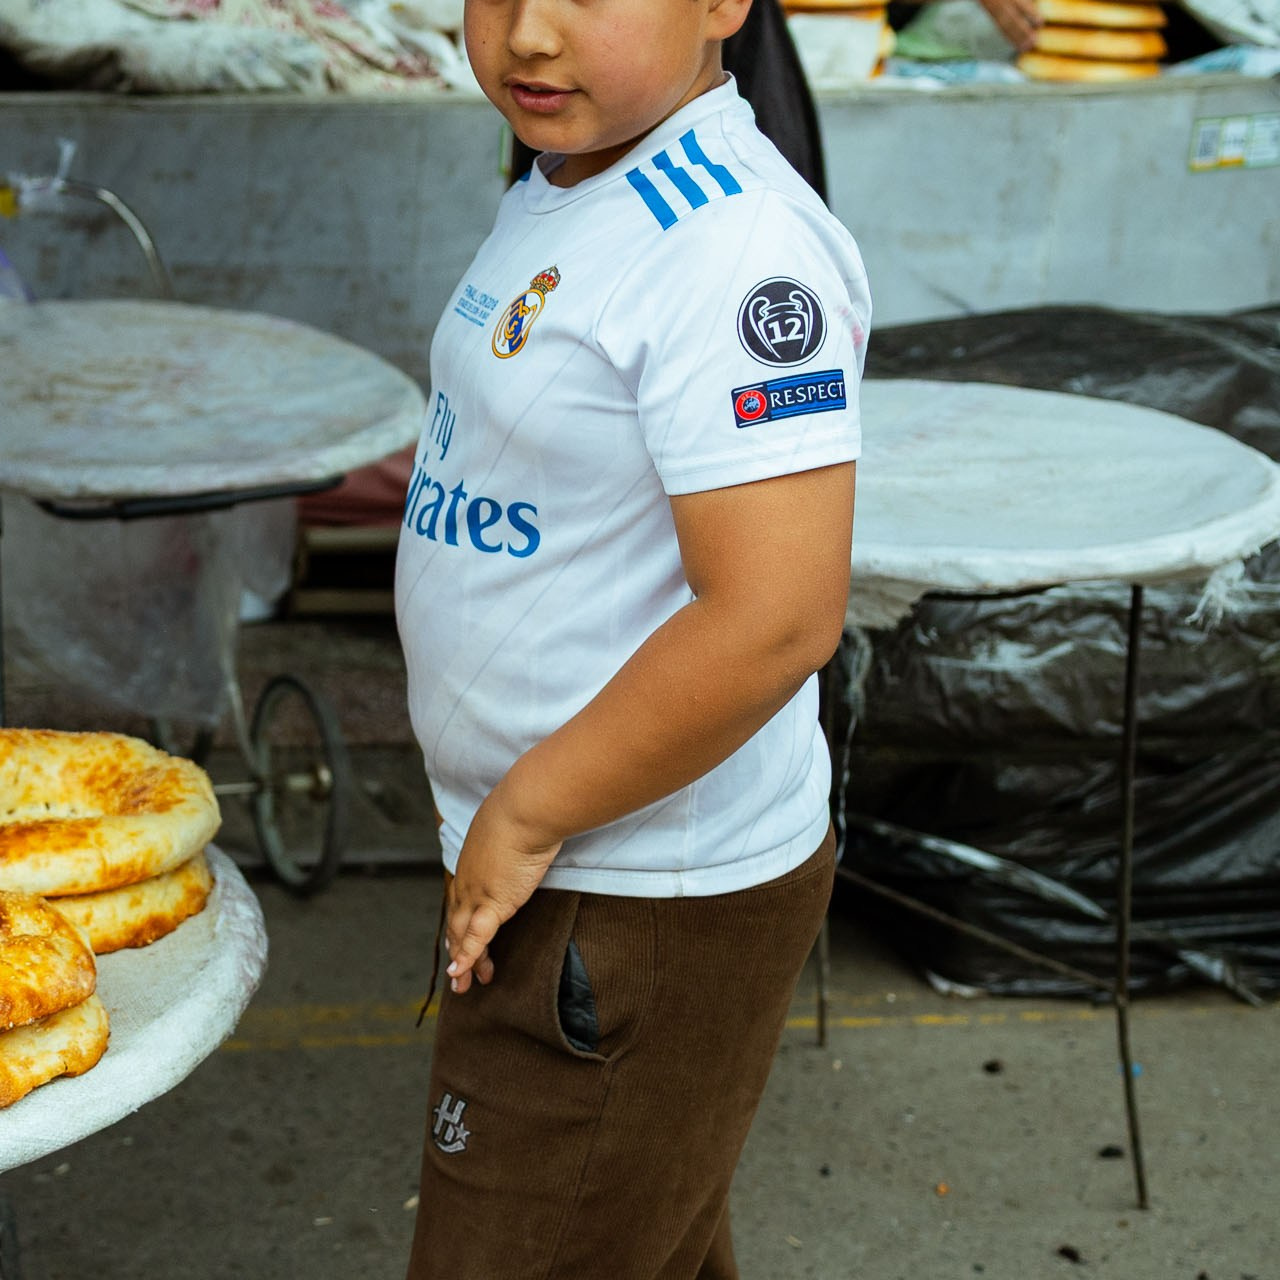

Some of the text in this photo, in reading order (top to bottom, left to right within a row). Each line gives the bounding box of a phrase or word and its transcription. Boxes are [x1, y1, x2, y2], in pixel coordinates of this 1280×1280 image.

[768, 317, 804, 345] 12
[770, 381, 844, 408] RESPECT
[429, 391, 456, 461] Fly
[404, 451, 541, 558] irates
